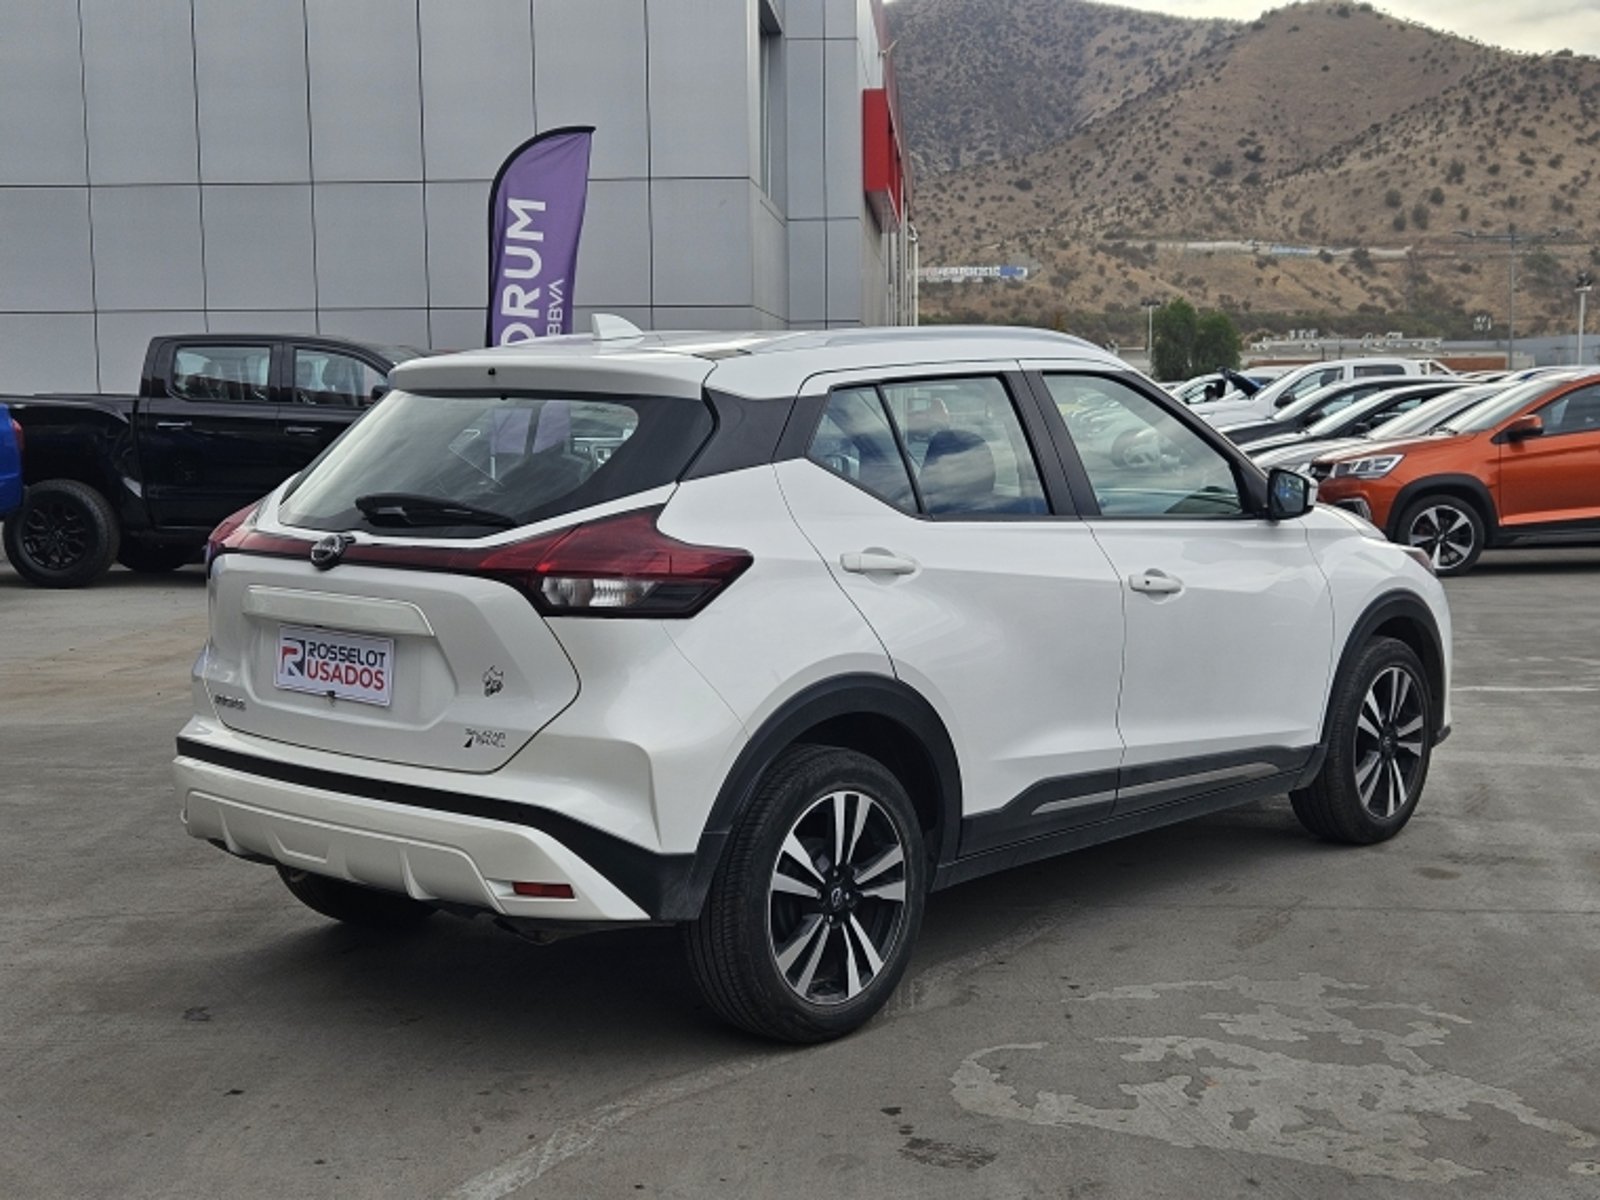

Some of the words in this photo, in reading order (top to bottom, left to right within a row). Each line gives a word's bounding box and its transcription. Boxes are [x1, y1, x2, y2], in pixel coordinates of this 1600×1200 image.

[547, 278, 565, 336] BBVA
[307, 641, 386, 668] ROSSELOT
[306, 659, 385, 691] USADOS
